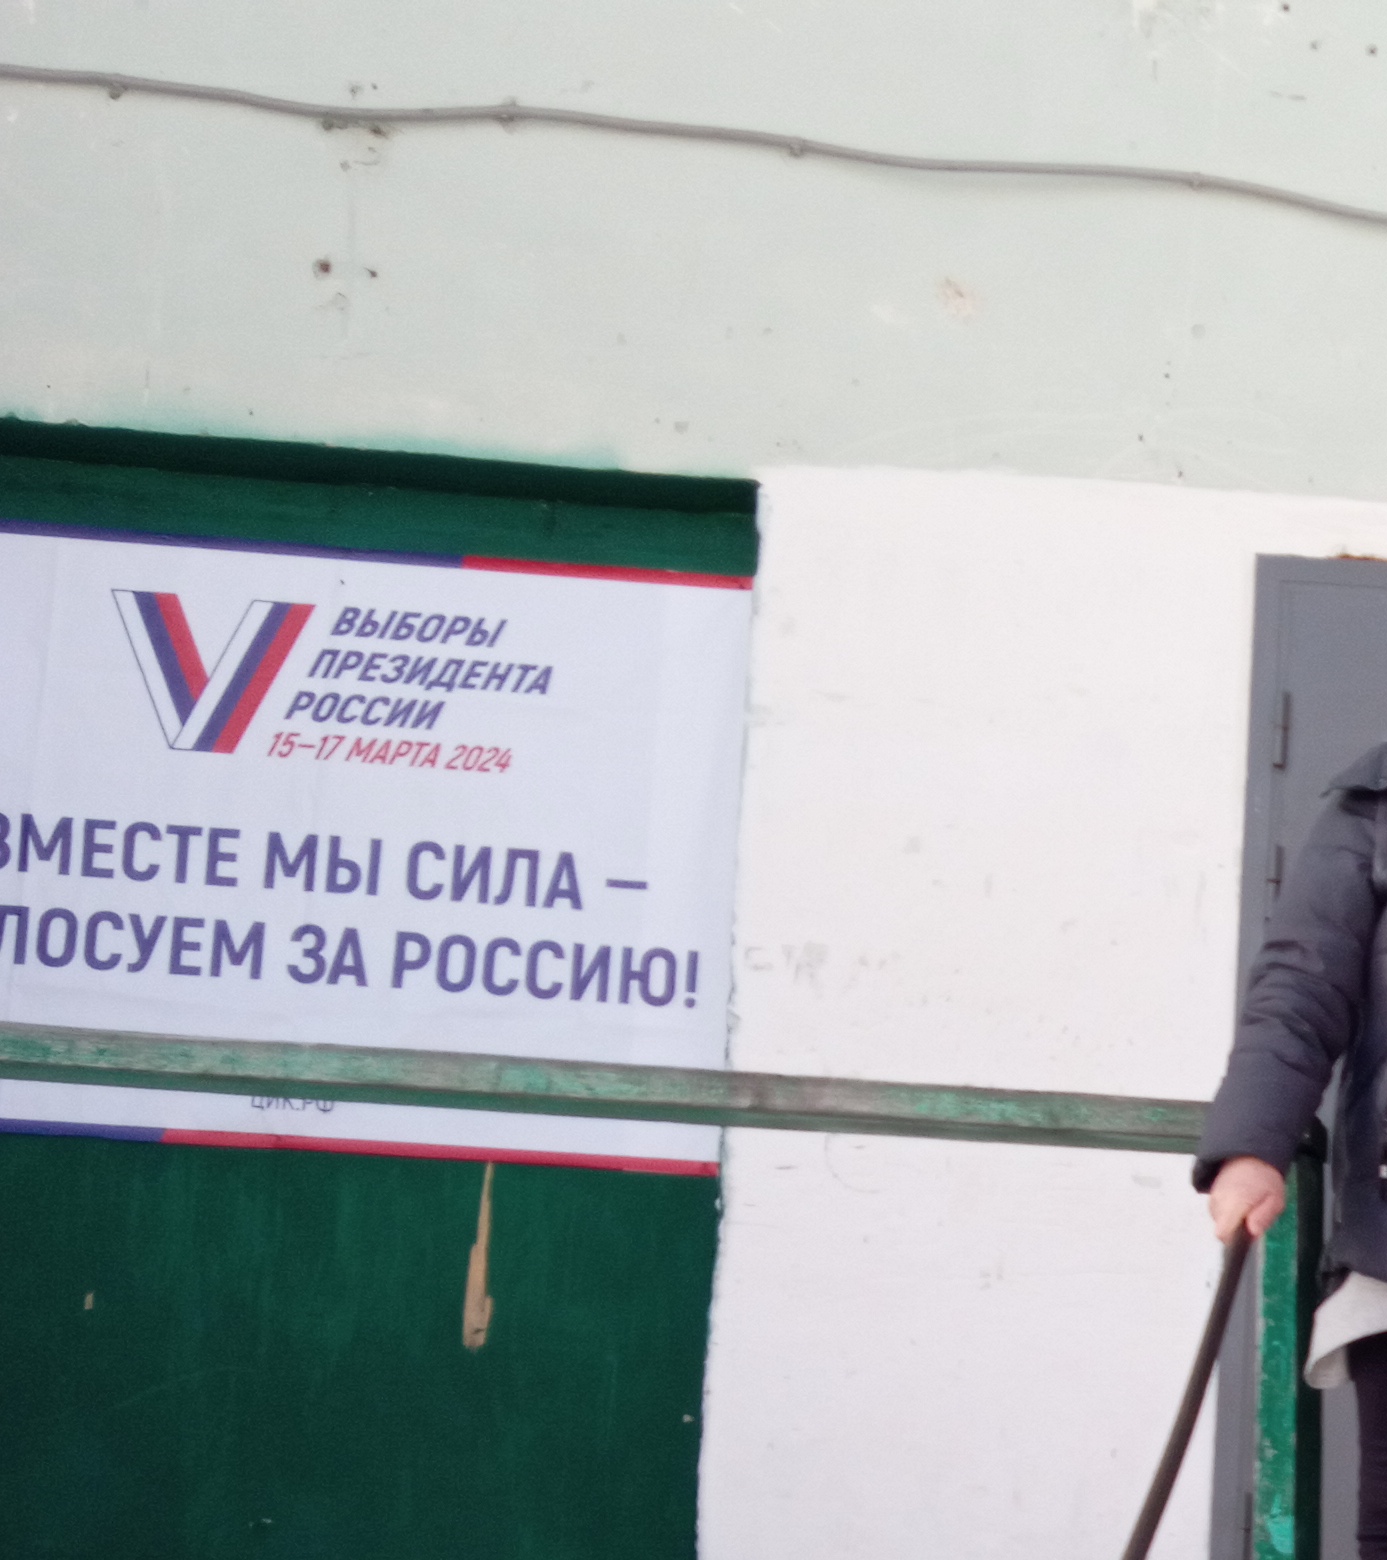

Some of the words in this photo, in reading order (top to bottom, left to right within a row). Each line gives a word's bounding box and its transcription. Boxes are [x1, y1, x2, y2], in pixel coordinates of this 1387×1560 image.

[330, 606, 508, 648] ВЫБОРЫ
[308, 649, 553, 695] ПРЕЗИДЕНТА
[284, 691, 446, 730] РОССИИ
[345, 737, 442, 768] МАРТА
[444, 744, 512, 773] 2024
[263, 831, 382, 896] МЫ
[406, 840, 584, 911] СИЛА
[287, 924, 368, 987] ЗА
[391, 931, 700, 1008] РОССИЮ!
